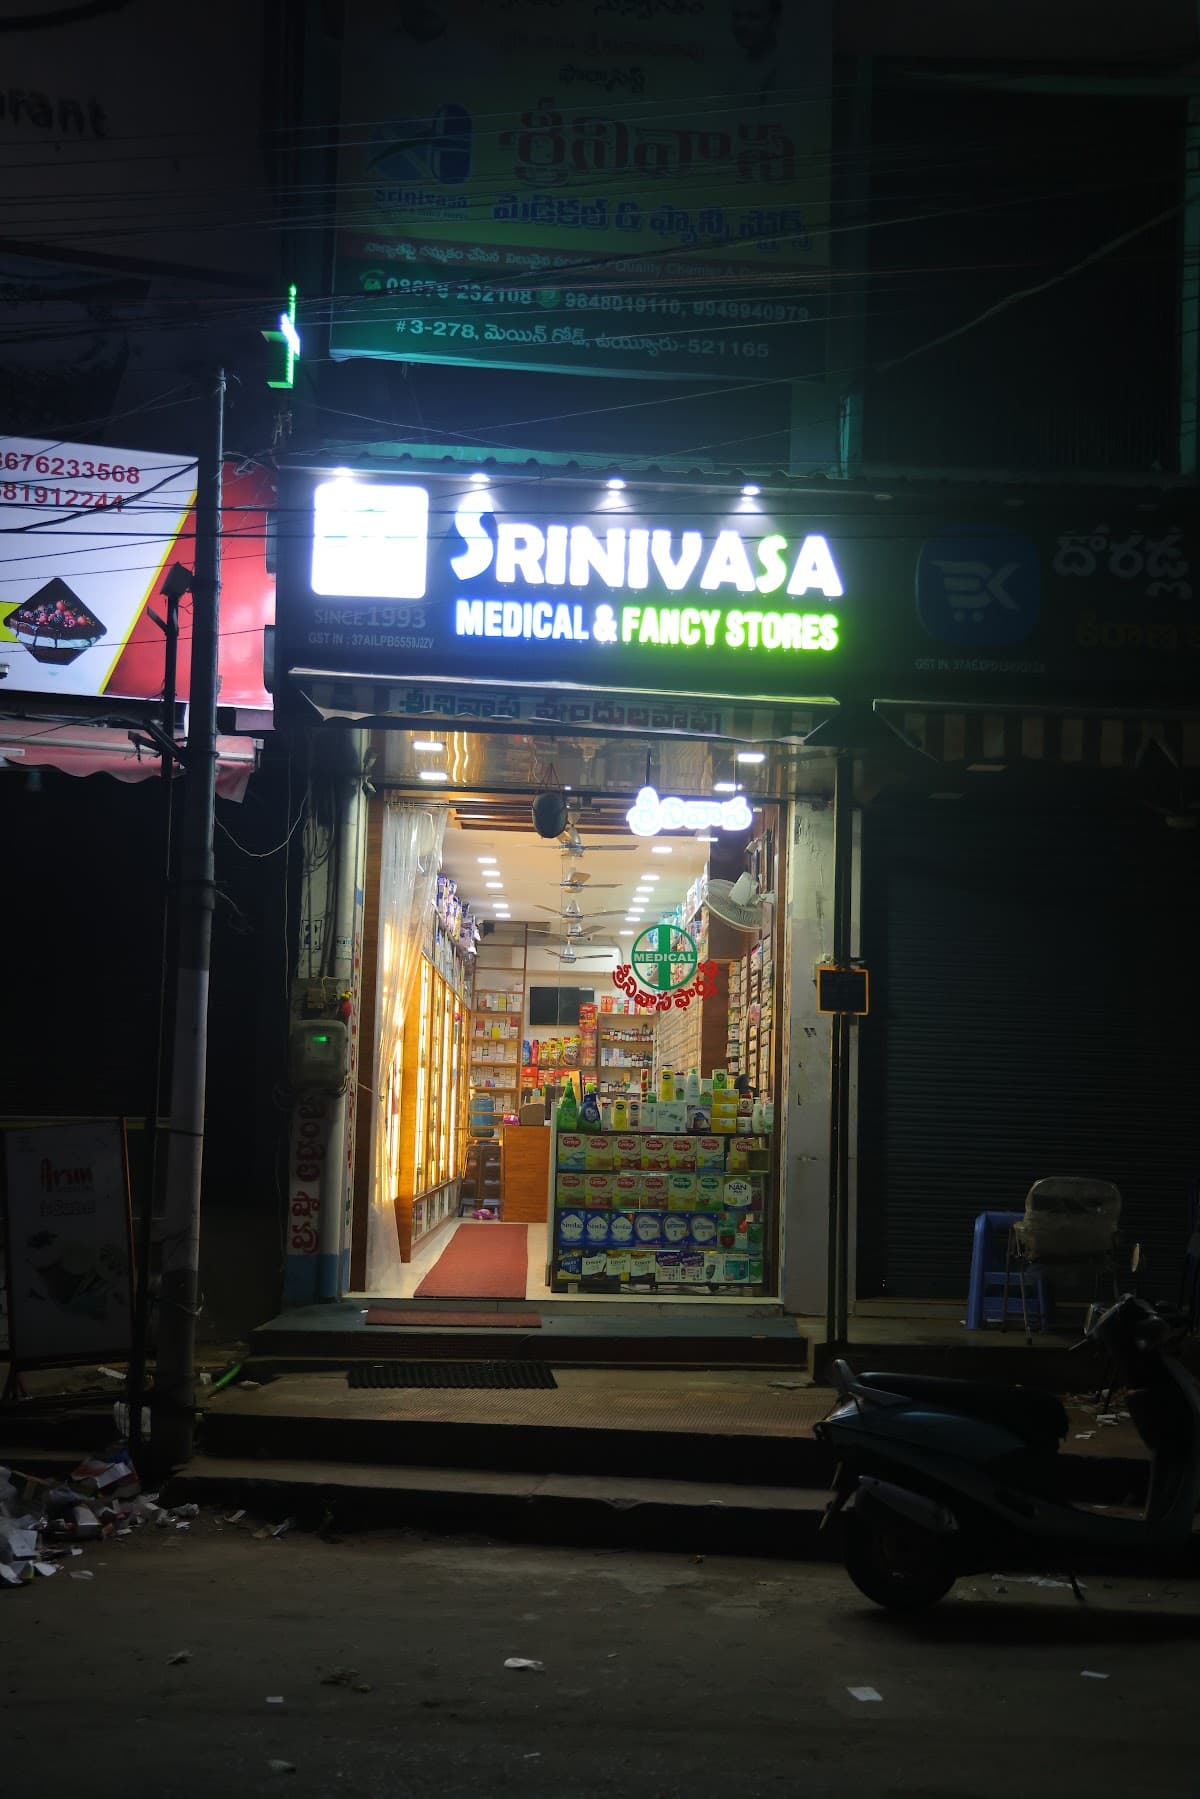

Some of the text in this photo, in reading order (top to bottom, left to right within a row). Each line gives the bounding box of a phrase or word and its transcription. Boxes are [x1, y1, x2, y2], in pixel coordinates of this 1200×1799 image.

[0, 451, 140, 485] 676233568
[313, 606, 427, 629] SINCE 1993
[455, 599, 840, 652] MEDICAL & FANCY STORES
[633, 951, 695, 963] MEDICAL
